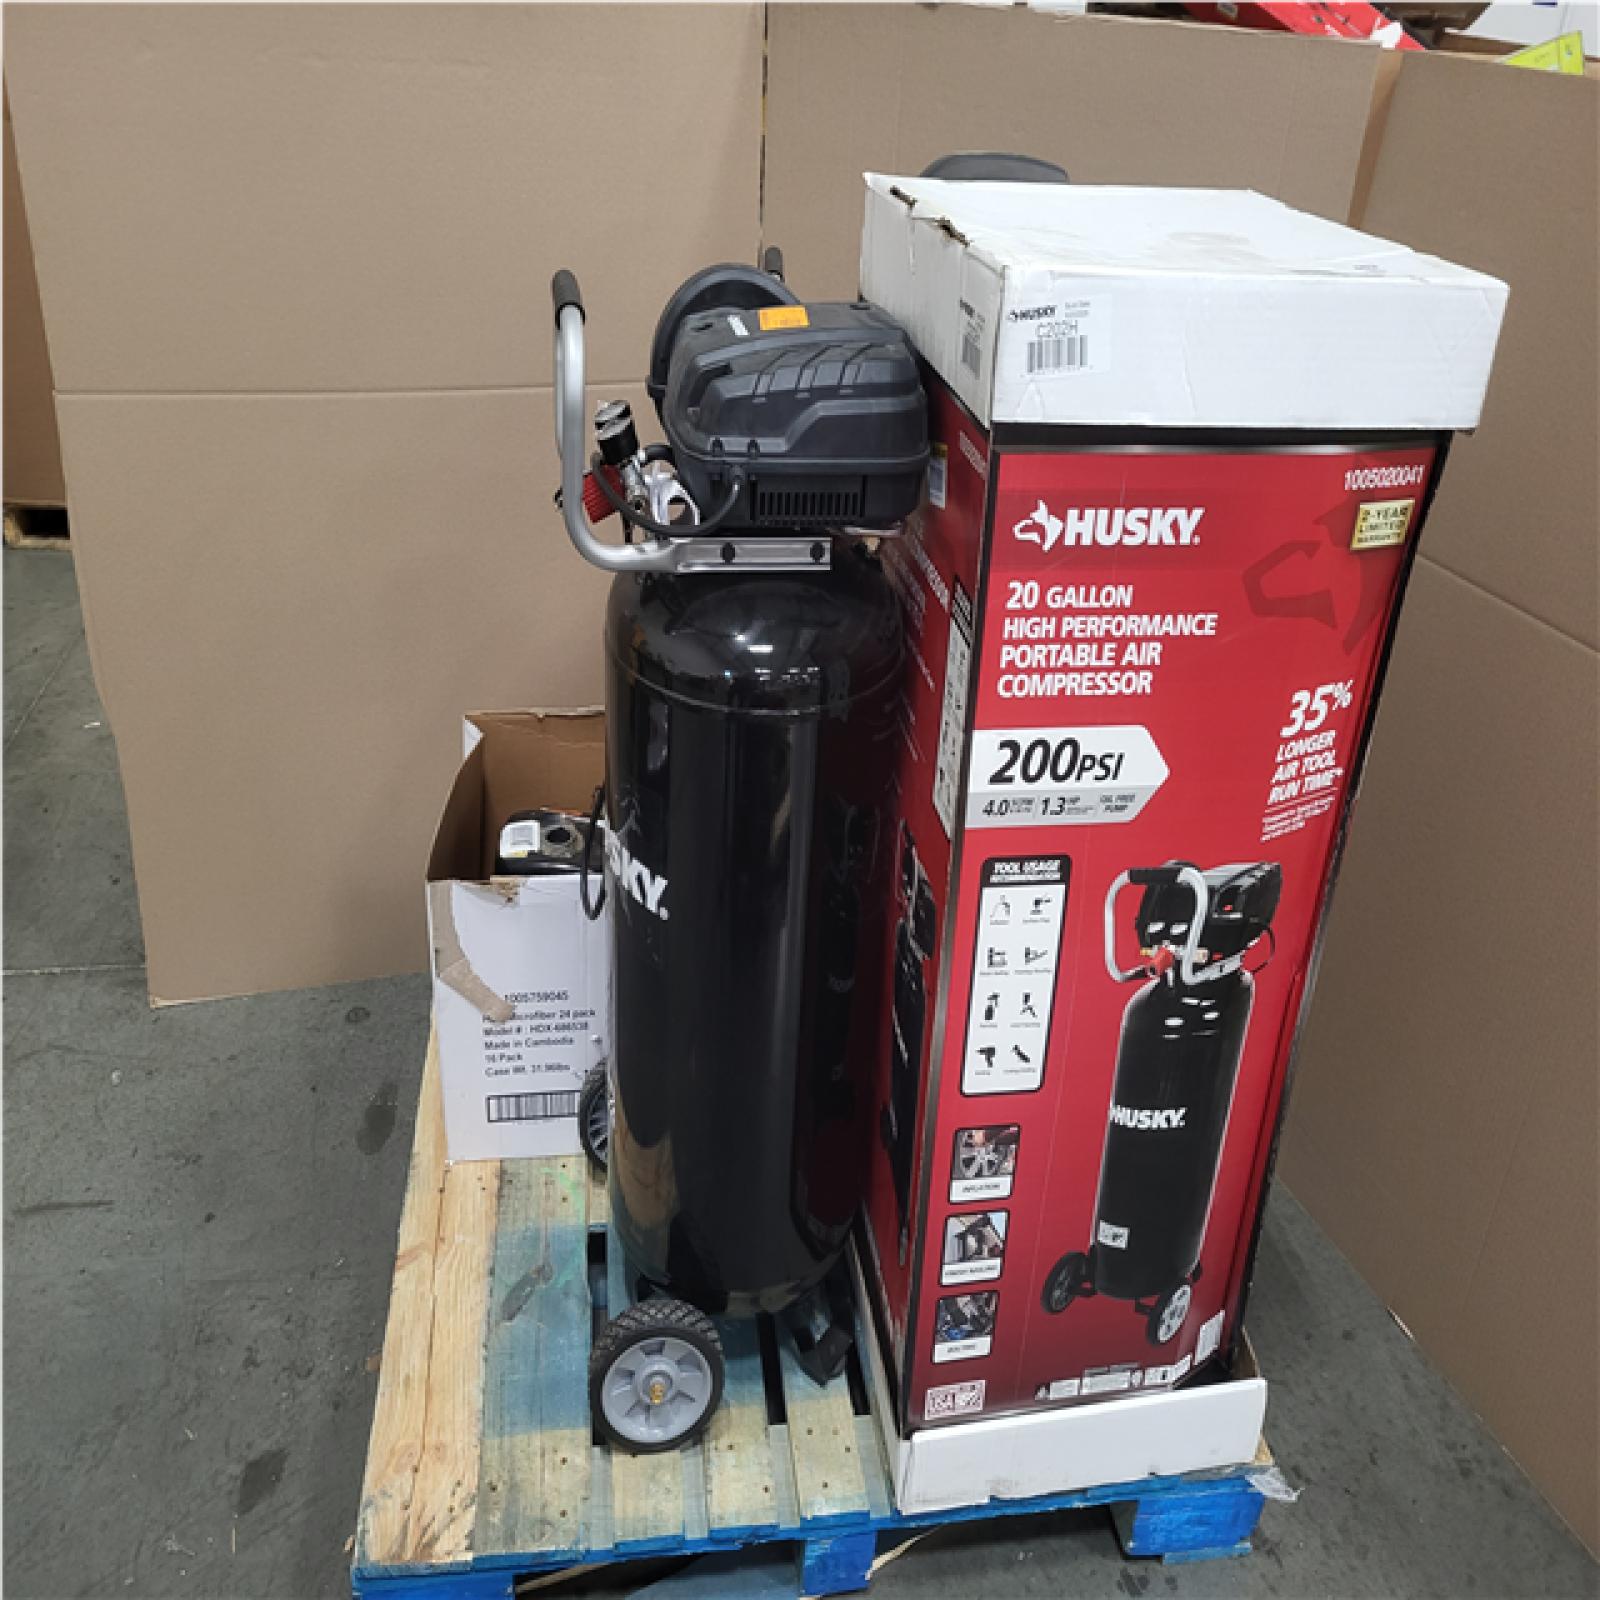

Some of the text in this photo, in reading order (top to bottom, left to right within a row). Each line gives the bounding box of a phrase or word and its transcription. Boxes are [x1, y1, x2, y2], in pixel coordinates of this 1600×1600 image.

[1018, 304, 1055, 321] HUSKY
[1064, 507, 1206, 546] HUSKY
[1006, 580, 1134, 609] 20 GALLON
[1003, 612, 1219, 640] HIGH PERFORMANCE
[1000, 641, 1163, 669] PORTABLE AIR
[997, 672, 1154, 698] COMPRESSOR
[1281, 679, 1353, 737] 35%
[1275, 730, 1337, 763] LONGER
[1270, 749, 1336, 784] AIR TOOL
[1268, 780, 1300, 805] RUN
[982, 798, 1010, 816] 4.0
[1042, 796, 1066, 816] 1.3
[994, 859, 1061, 874] TOOL USAGE
[572, 1009, 596, 1019] pack
[483, 1027, 513, 1036] Model
[484, 1036, 574, 1050] Made in Cambodia
[499, 1053, 523, 1062] Pack
[485, 1066, 510, 1078] Case
[1110, 1105, 1187, 1131] HUSKY
